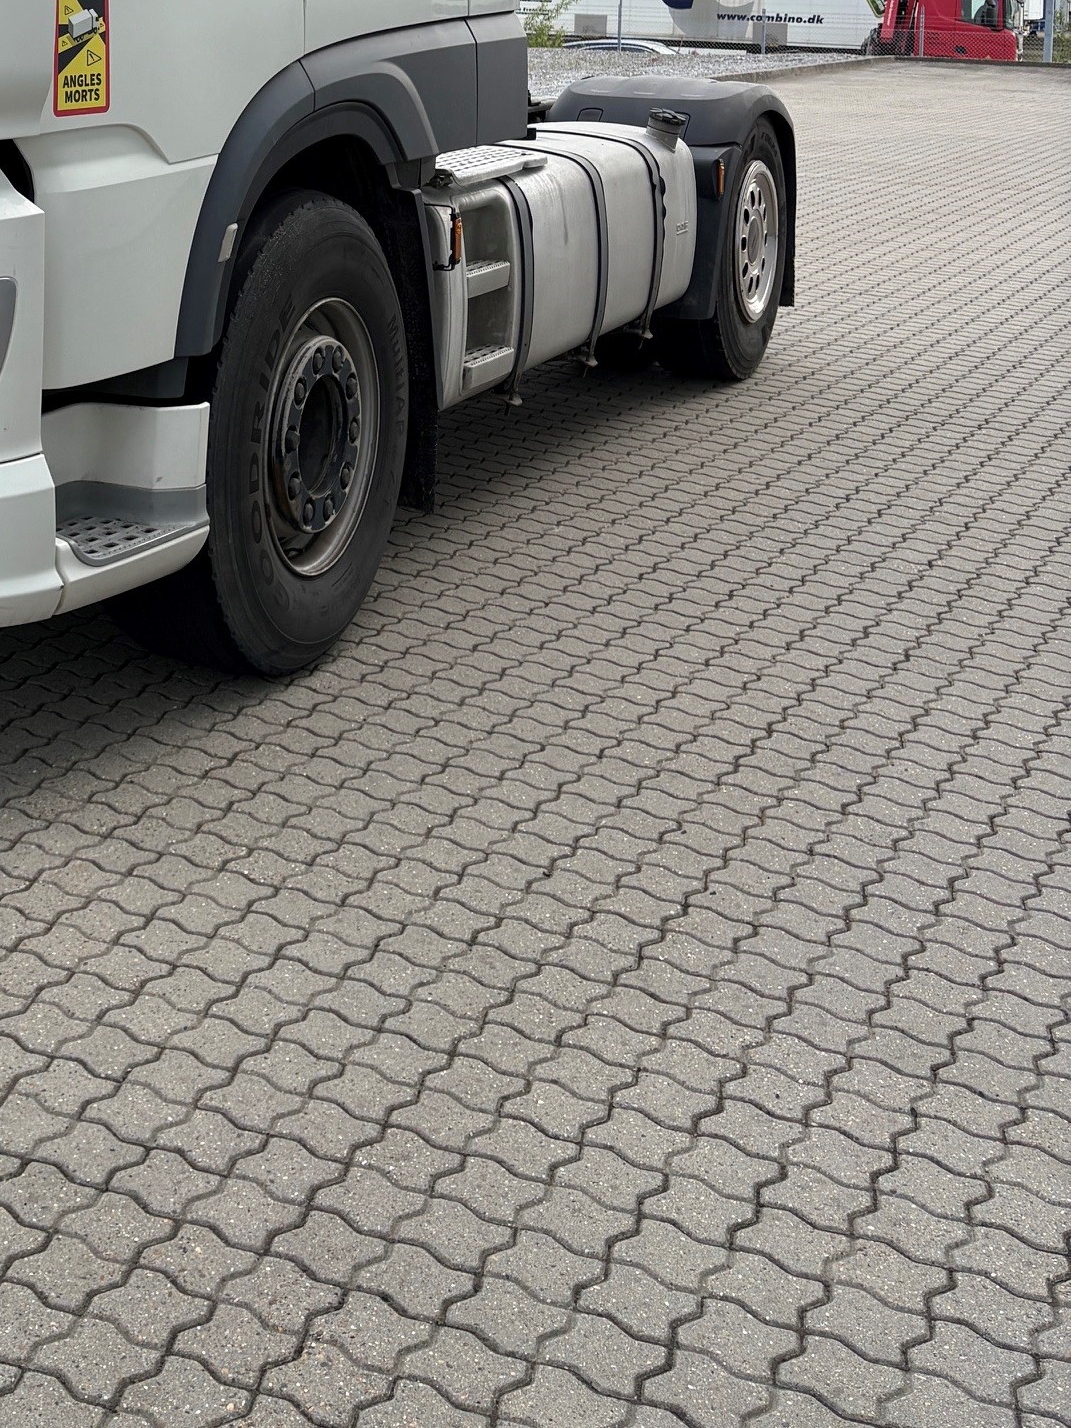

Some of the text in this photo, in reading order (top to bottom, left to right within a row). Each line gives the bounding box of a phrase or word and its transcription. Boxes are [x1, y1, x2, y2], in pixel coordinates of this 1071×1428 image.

[716, 13, 825, 25] www.combino.dk
[62, 73, 102, 89] ANGLES
[64, 88, 101, 104] MORTS
[249, 291, 295, 615] GOODRIDE
